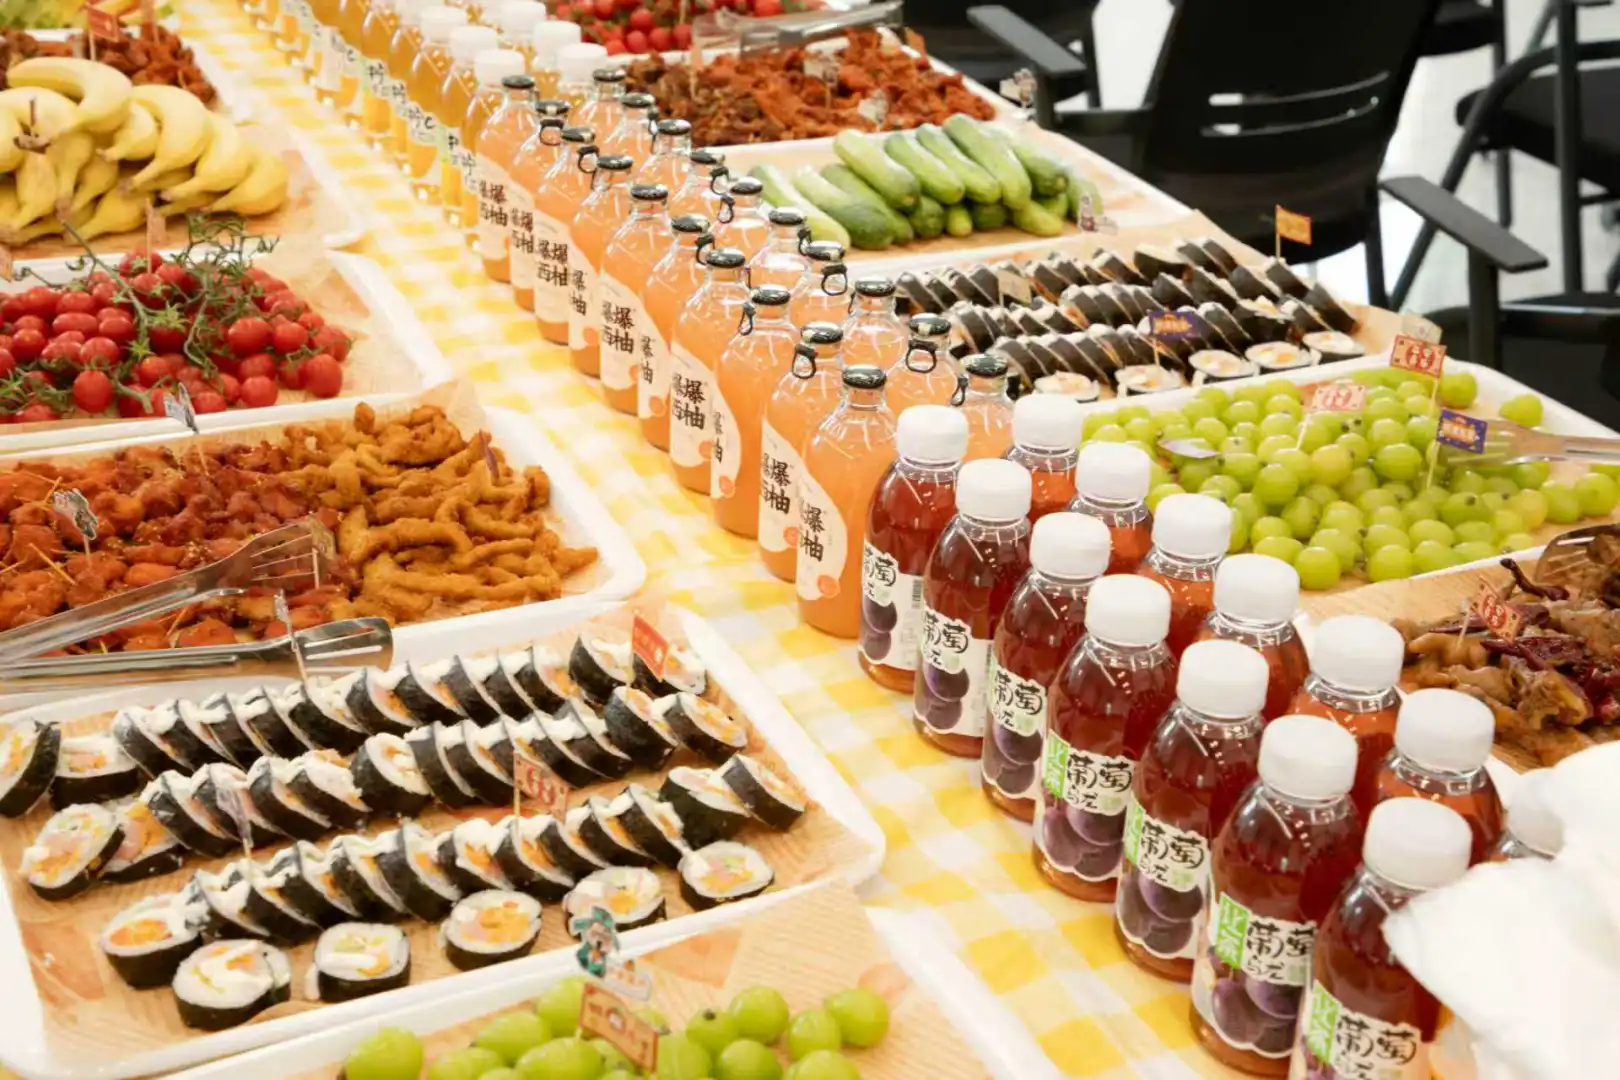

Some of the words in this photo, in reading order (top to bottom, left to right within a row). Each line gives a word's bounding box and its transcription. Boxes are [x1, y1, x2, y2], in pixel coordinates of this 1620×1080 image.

[799, 524, 824, 562] 柚
[994, 670, 1043, 716] 葡萄
[1067, 754, 1132, 793] 葡萄
[1141, 820, 1204, 869] 葡萄
[1337, 1014, 1417, 1065] 葡萄
